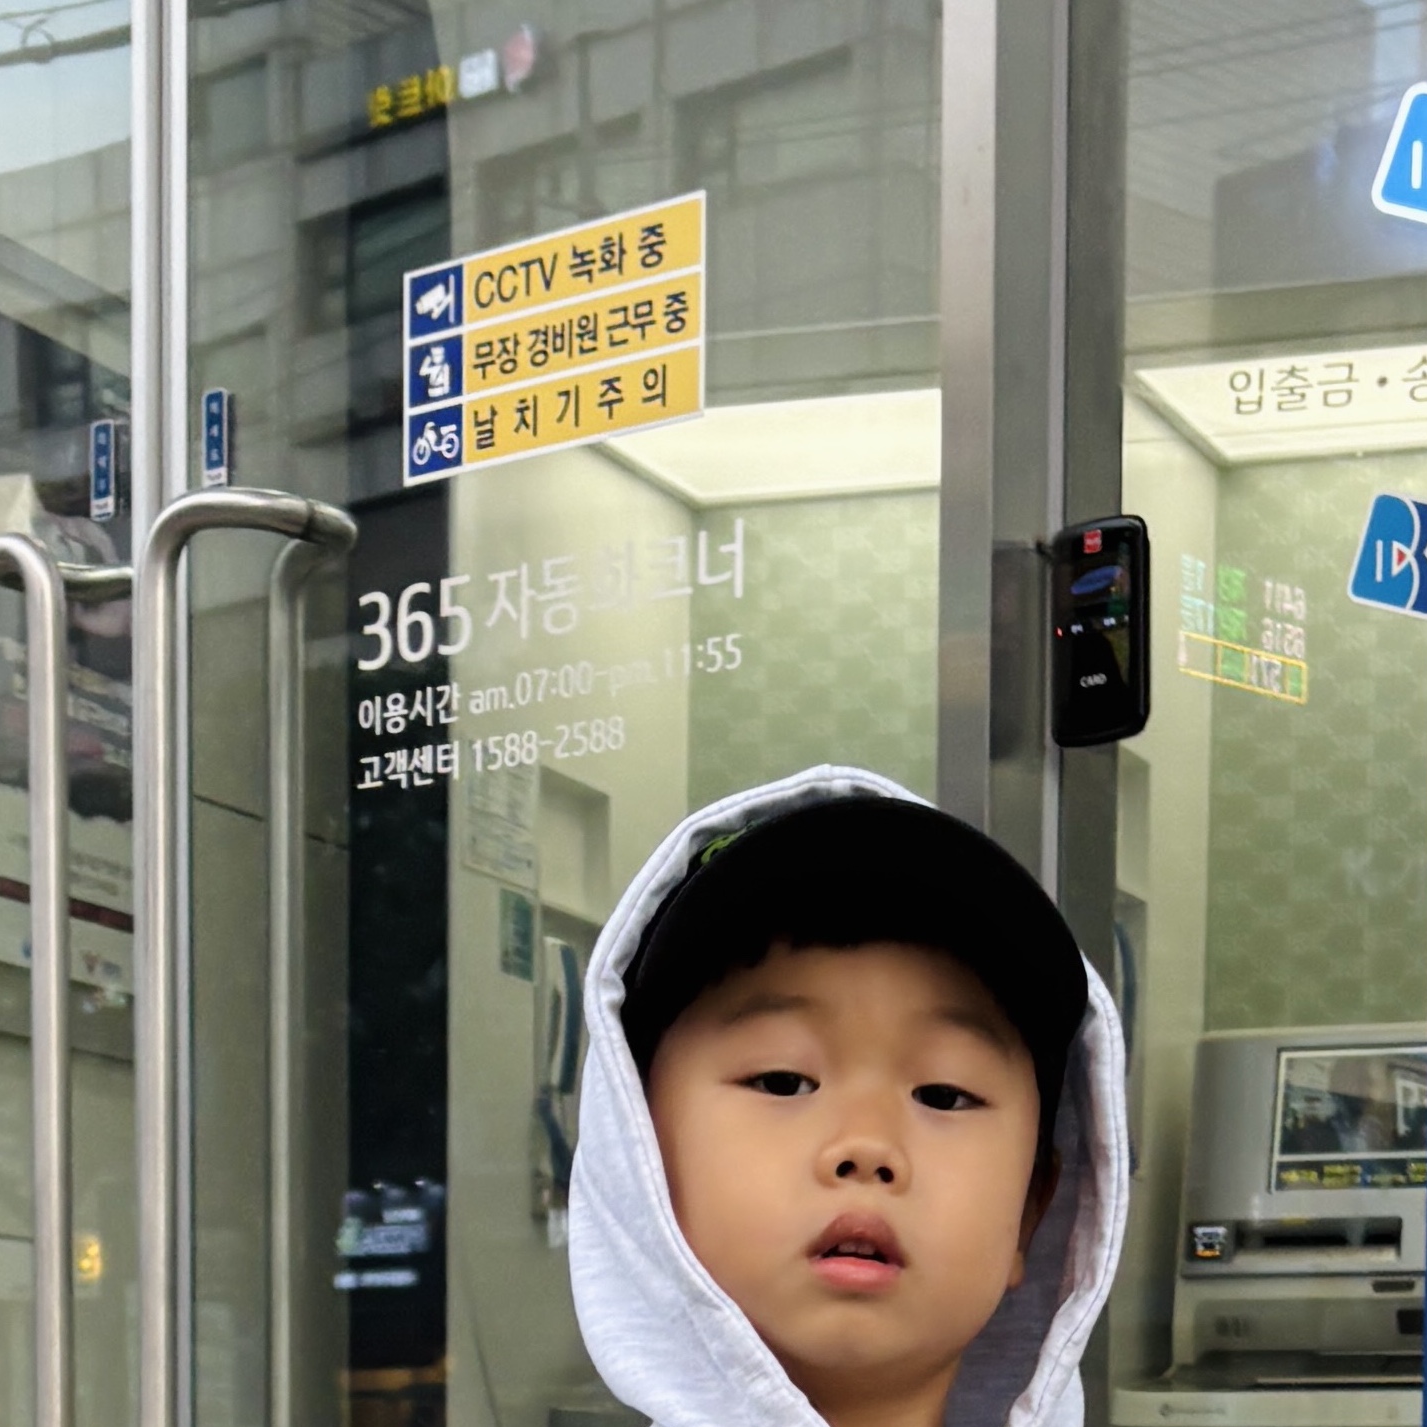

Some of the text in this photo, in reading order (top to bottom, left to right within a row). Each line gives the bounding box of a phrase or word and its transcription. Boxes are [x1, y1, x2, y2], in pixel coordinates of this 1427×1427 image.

[473, 223, 667, 308] CCTV 녹화 중
[473, 291, 689, 380] 무장 경비원 근무 중
[357, 573, 473, 671] 365
[358, 682, 462, 737] 이용시간
[1080, 672, 1107, 688] CARD
[357, 716, 626, 790] 고객센터 1588-2588
